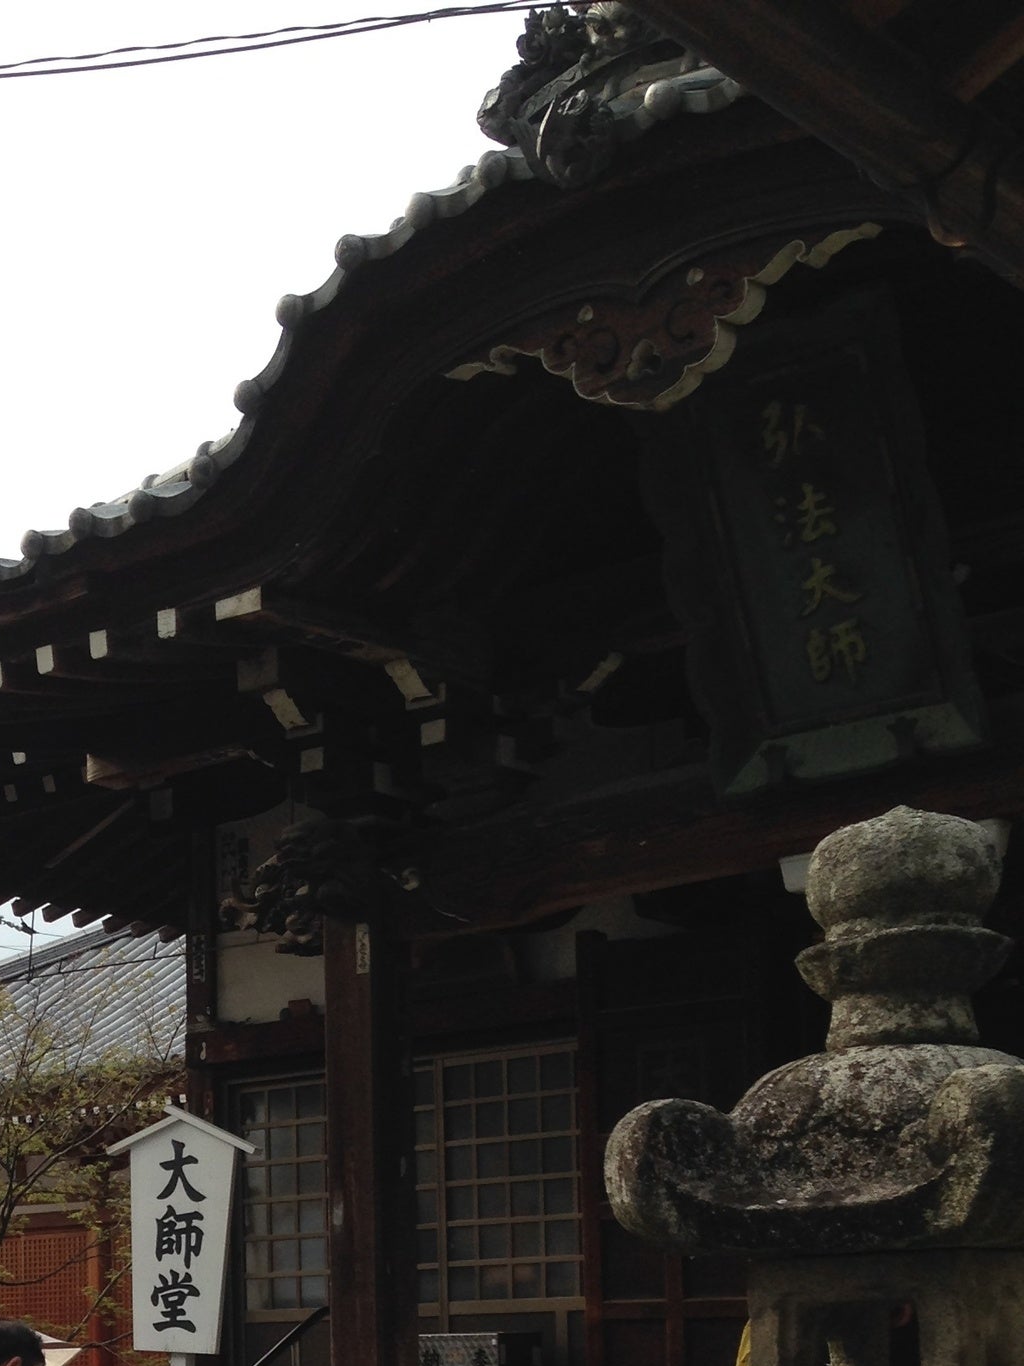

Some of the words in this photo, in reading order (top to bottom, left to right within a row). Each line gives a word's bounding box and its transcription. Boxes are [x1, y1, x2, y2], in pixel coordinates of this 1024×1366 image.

[760, 399, 869, 684] 弘法大師
[150, 1139, 206, 1334] 大師堂
